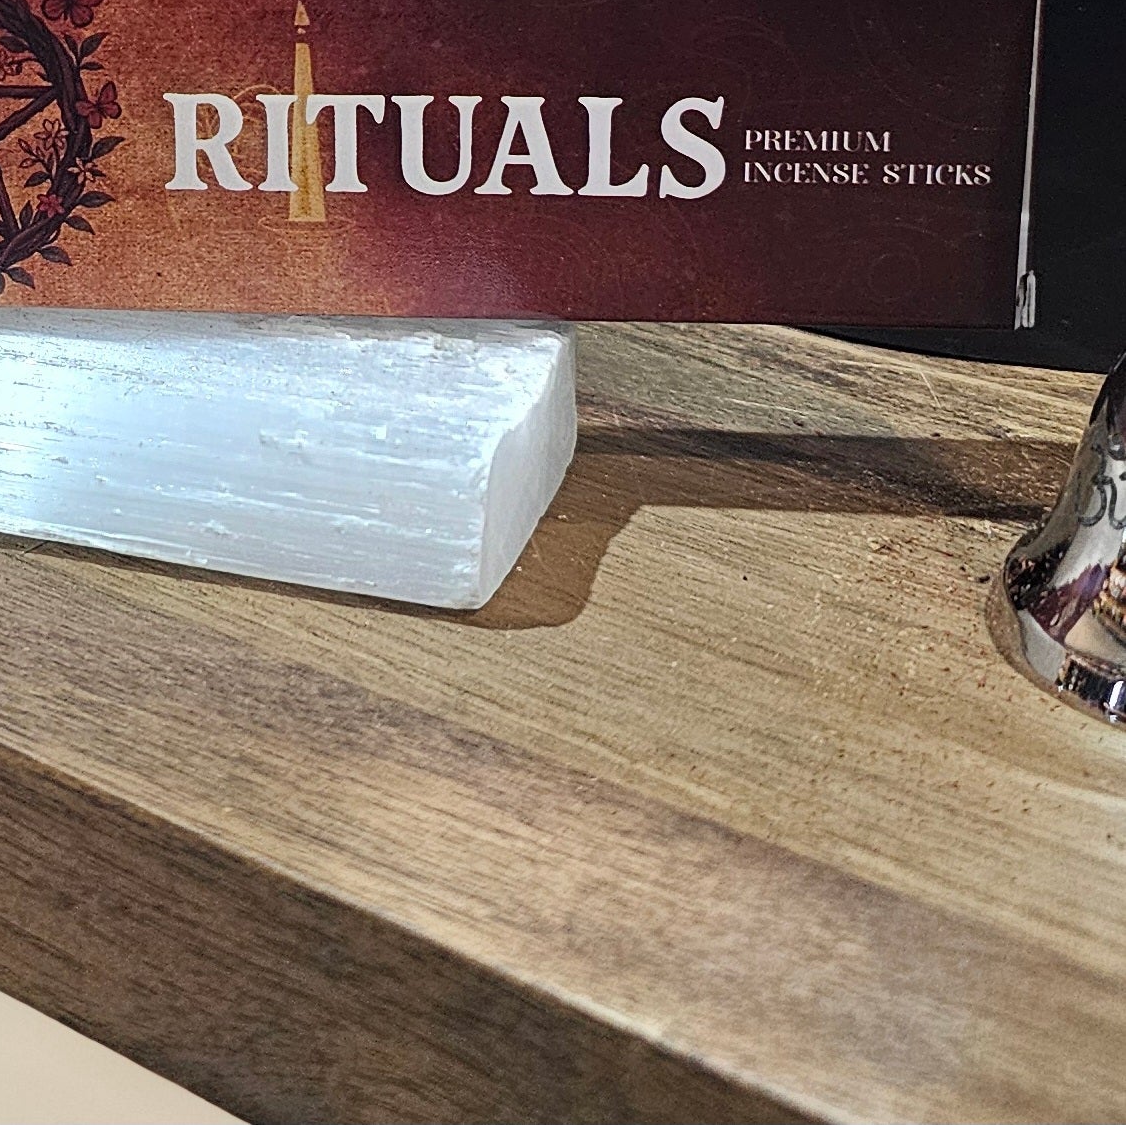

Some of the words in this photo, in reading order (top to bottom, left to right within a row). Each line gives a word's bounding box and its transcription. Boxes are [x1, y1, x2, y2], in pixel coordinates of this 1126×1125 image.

[162, 93, 727, 199] RITUALS
[745, 129, 891, 152] PREMIUM
[744, 162, 869, 184] INCENSE
[883, 163, 992, 186] STICKS
